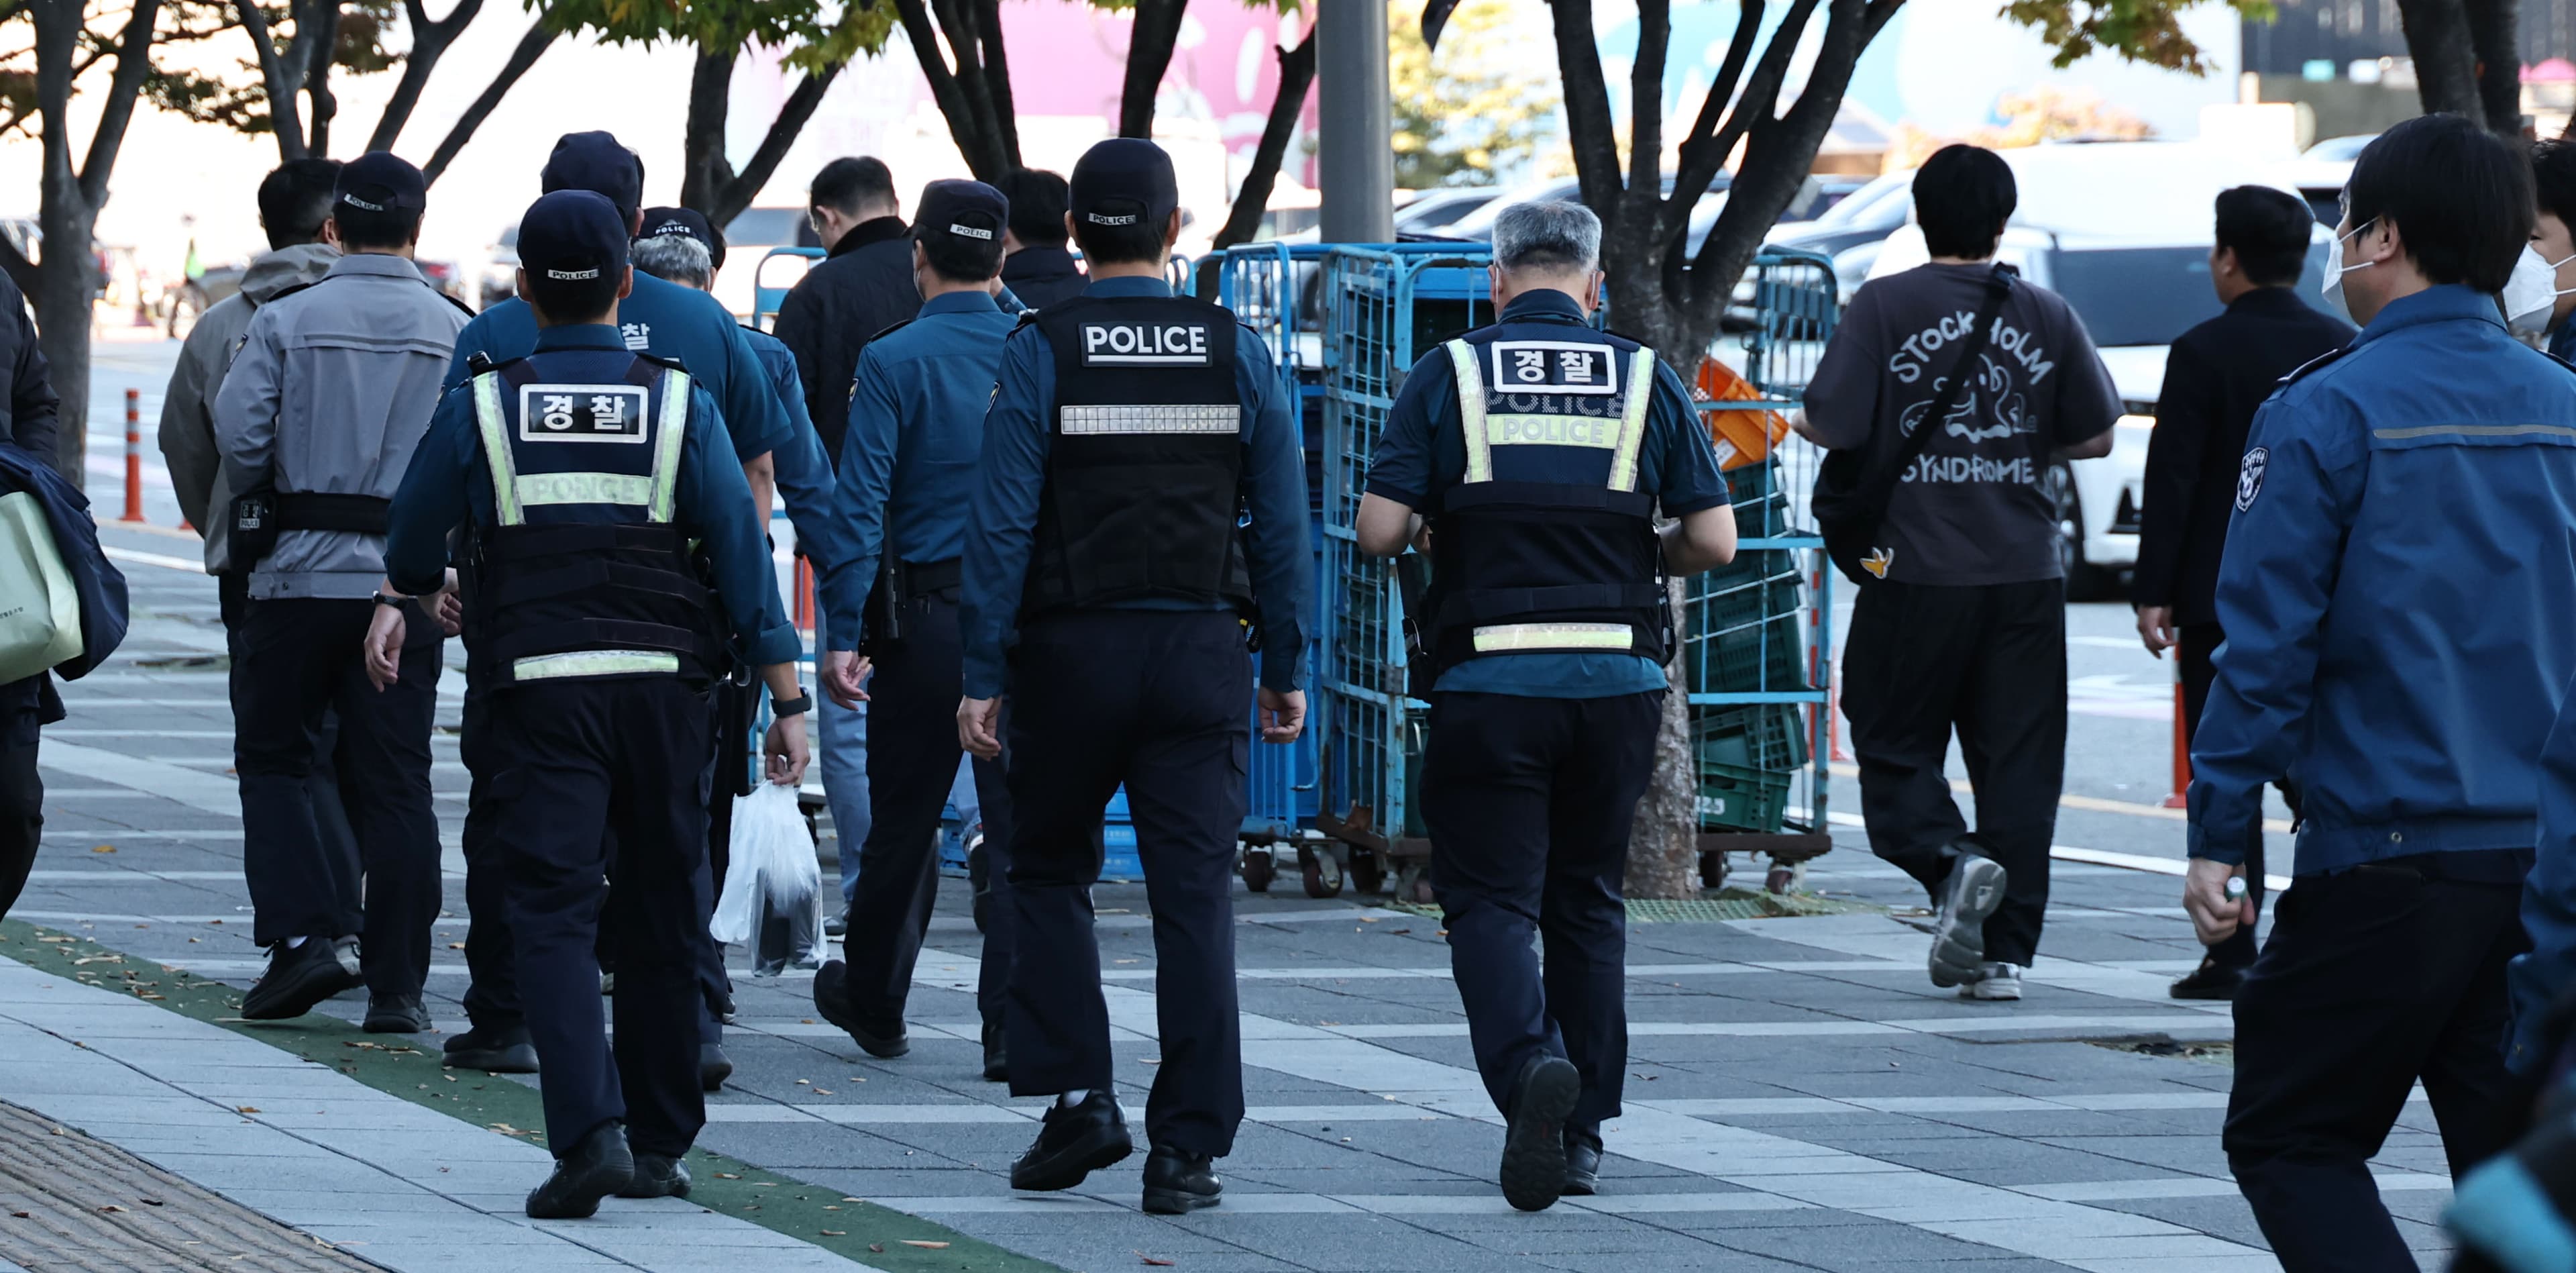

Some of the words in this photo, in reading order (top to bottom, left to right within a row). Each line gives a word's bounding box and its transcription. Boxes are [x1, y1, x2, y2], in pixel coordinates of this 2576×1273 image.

[1093, 215, 1134, 223] POLICE
[655, 225, 690, 235] POLICE
[957, 227, 991, 238] POLICE
[553, 271, 596, 280] POLICE
[1085, 326, 1207, 354] POLICE
[1514, 350, 1593, 383] 경찰
[543, 395, 625, 430] 경찰
[1503, 418, 1605, 444] POLICE
